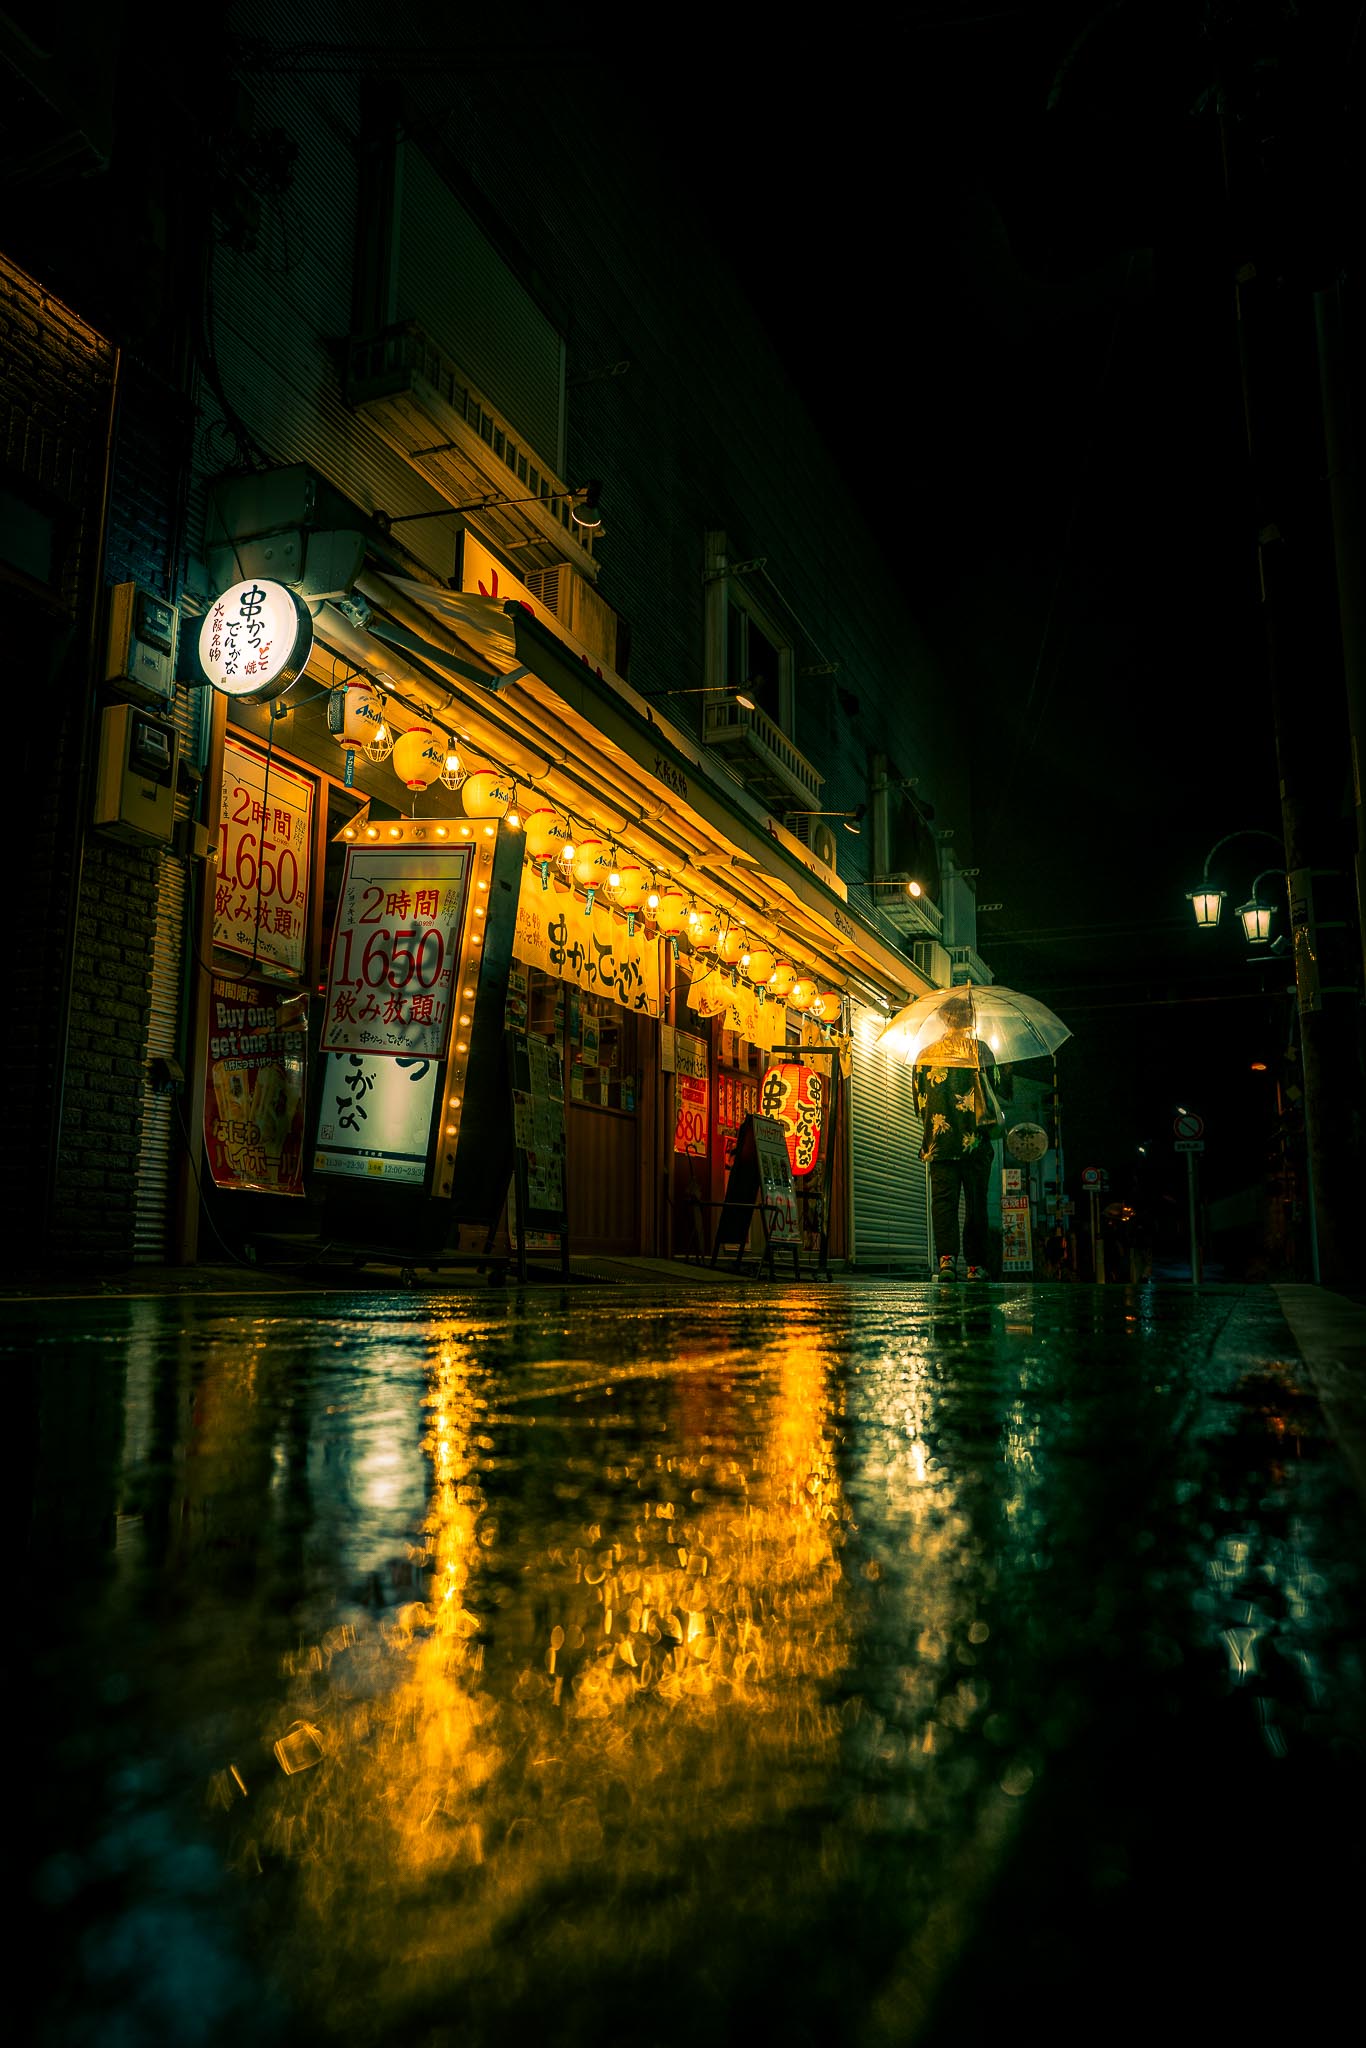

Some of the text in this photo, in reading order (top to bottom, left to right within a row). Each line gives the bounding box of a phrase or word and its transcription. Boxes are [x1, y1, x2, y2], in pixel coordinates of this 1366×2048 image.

[209, 602, 225, 662] 大阪名物
[240, 584, 267, 649] 串かつ
[224, 621, 242, 675] でんがな
[231, 787, 292, 842] 2時間
[214, 884, 301, 940] 飲み放題!!
[359, 886, 440, 925] 2時間
[335, 928, 445, 995] 1,650
[216, 1002, 277, 1030] Buy one
[332, 990, 447, 1027] 飲み放題!!
[210, 1031, 240, 1060] get
[239, 1034, 269, 1055] one
[268, 1031, 304, 1053] free
[212, 1119, 261, 1146] なにわ
[675, 1110, 704, 1143] 880
[796, 1101, 816, 1166] でんがな
[215, 1144, 298, 1178] ハイボール
